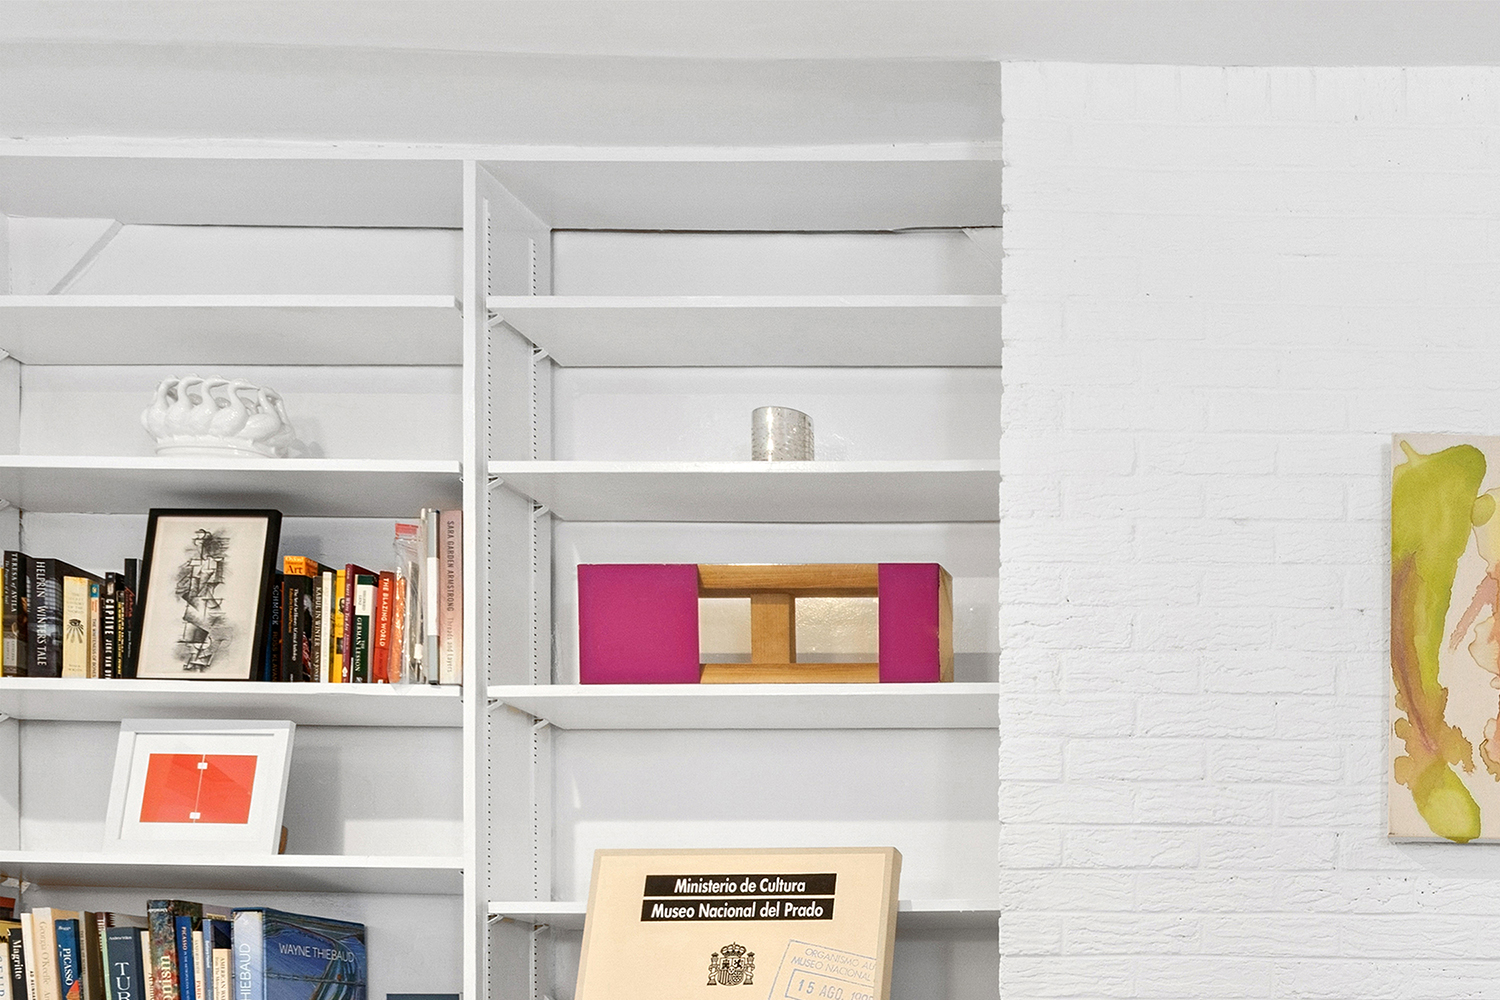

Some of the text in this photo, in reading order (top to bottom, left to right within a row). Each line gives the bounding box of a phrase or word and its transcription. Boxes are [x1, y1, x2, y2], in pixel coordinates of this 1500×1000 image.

[36, 561, 47, 666] HELPRIN WINTER'S TALE
[105, 598, 114, 635] CAPTIVE
[315, 610, 321, 619] IN
[379, 578, 390, 647] THE BLAZING WORLD
[354, 647, 362, 672] LESSON
[674, 878, 806, 894] Ministerio de Cultura
[651, 901, 823, 919] Museo Nacional del Prado
[11, 939, 24, 980] Magritte
[278, 942, 355, 963] WAYNE THIEBAUD
[804, 948, 859, 968] ORGANISMO
[62, 948, 73, 986] PICASSO
[791, 956, 871, 982] MUSEO NACIONAL
[797, 979, 815, 995] 15
